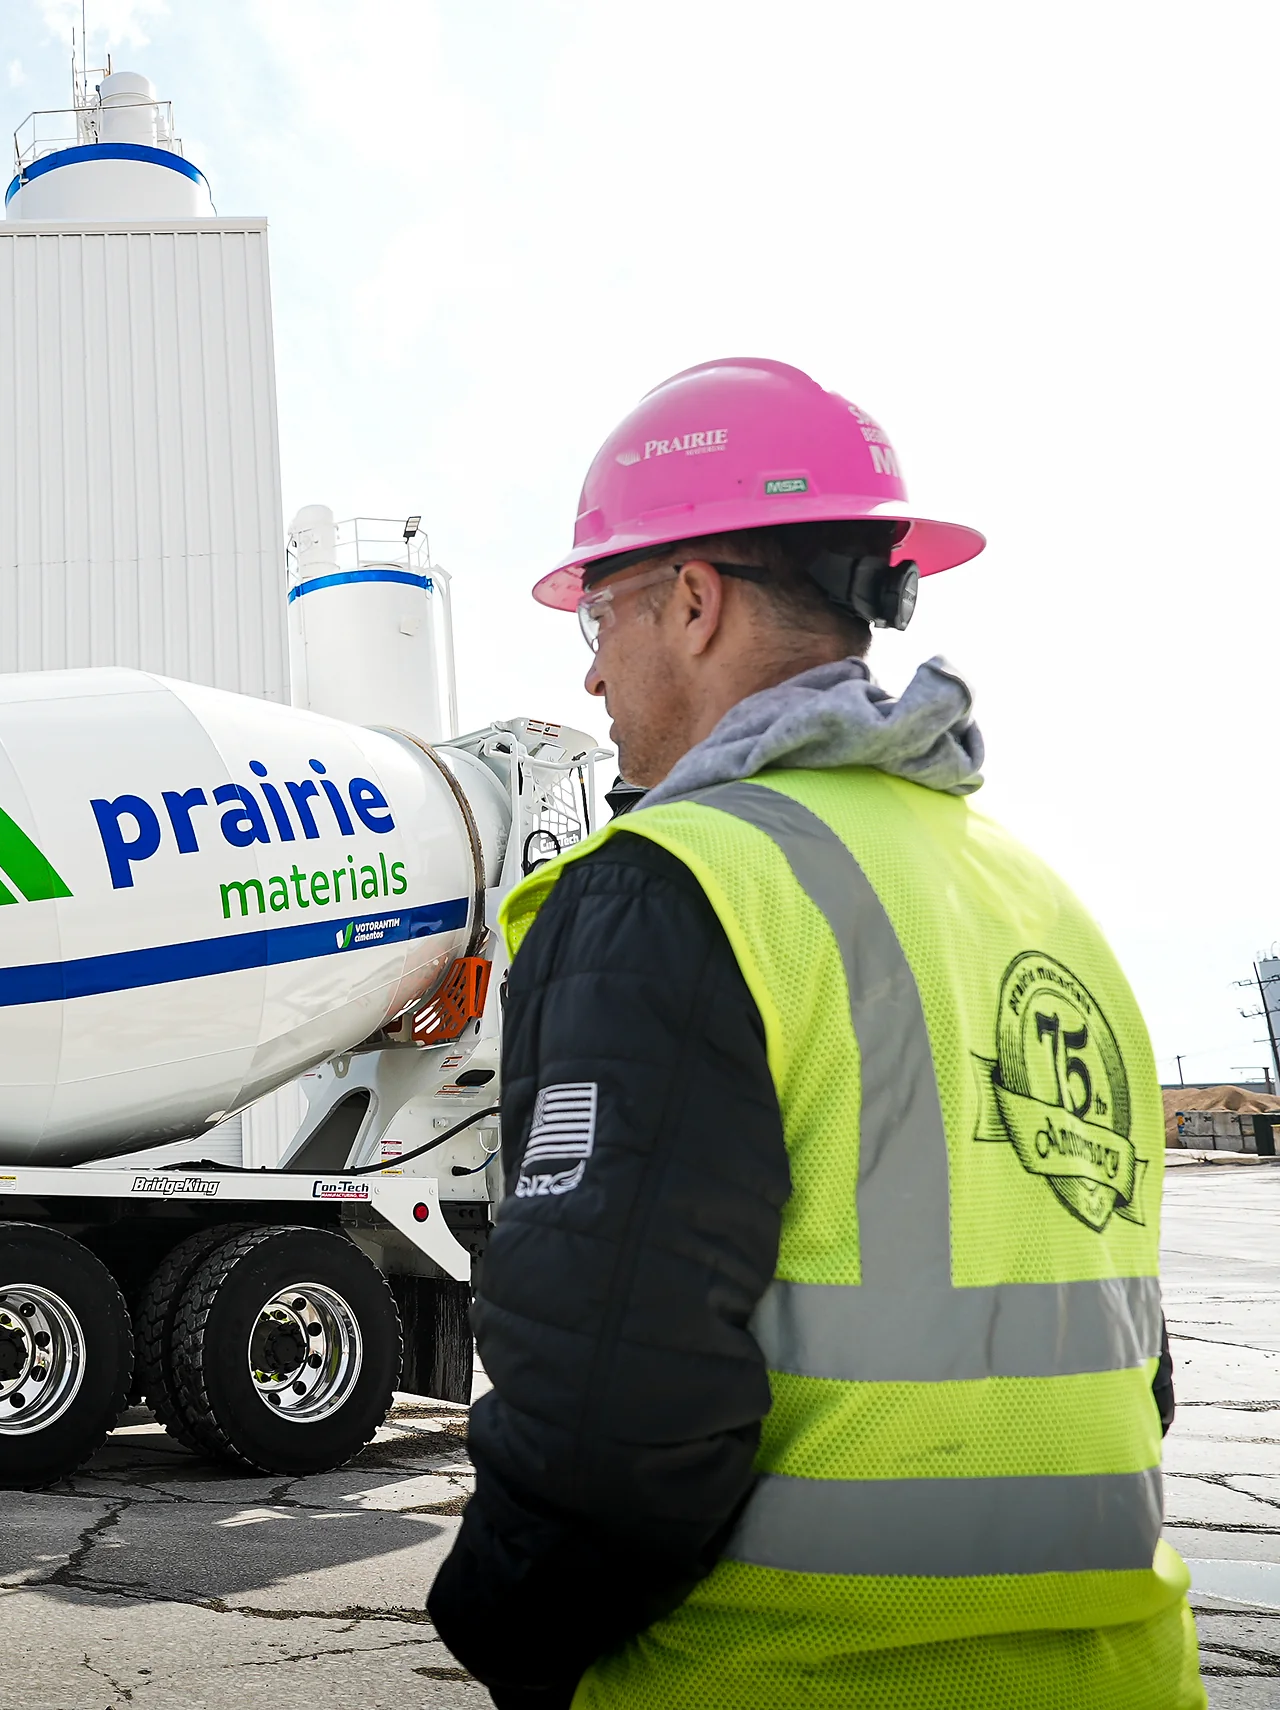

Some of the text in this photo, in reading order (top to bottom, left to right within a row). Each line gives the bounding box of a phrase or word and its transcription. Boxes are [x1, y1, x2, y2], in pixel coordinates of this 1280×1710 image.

[643, 429, 728, 460] PRAIRIE
[767, 479, 806, 493] MSA
[89, 758, 395, 889] prairie
[219, 852, 408, 919] materials
[355, 918, 400, 933] VOTORANTIM
[354, 931, 384, 943] cimentos
[131, 1177, 221, 1196] BridgeKing
[312, 1180, 369, 1198] Con-Tech
